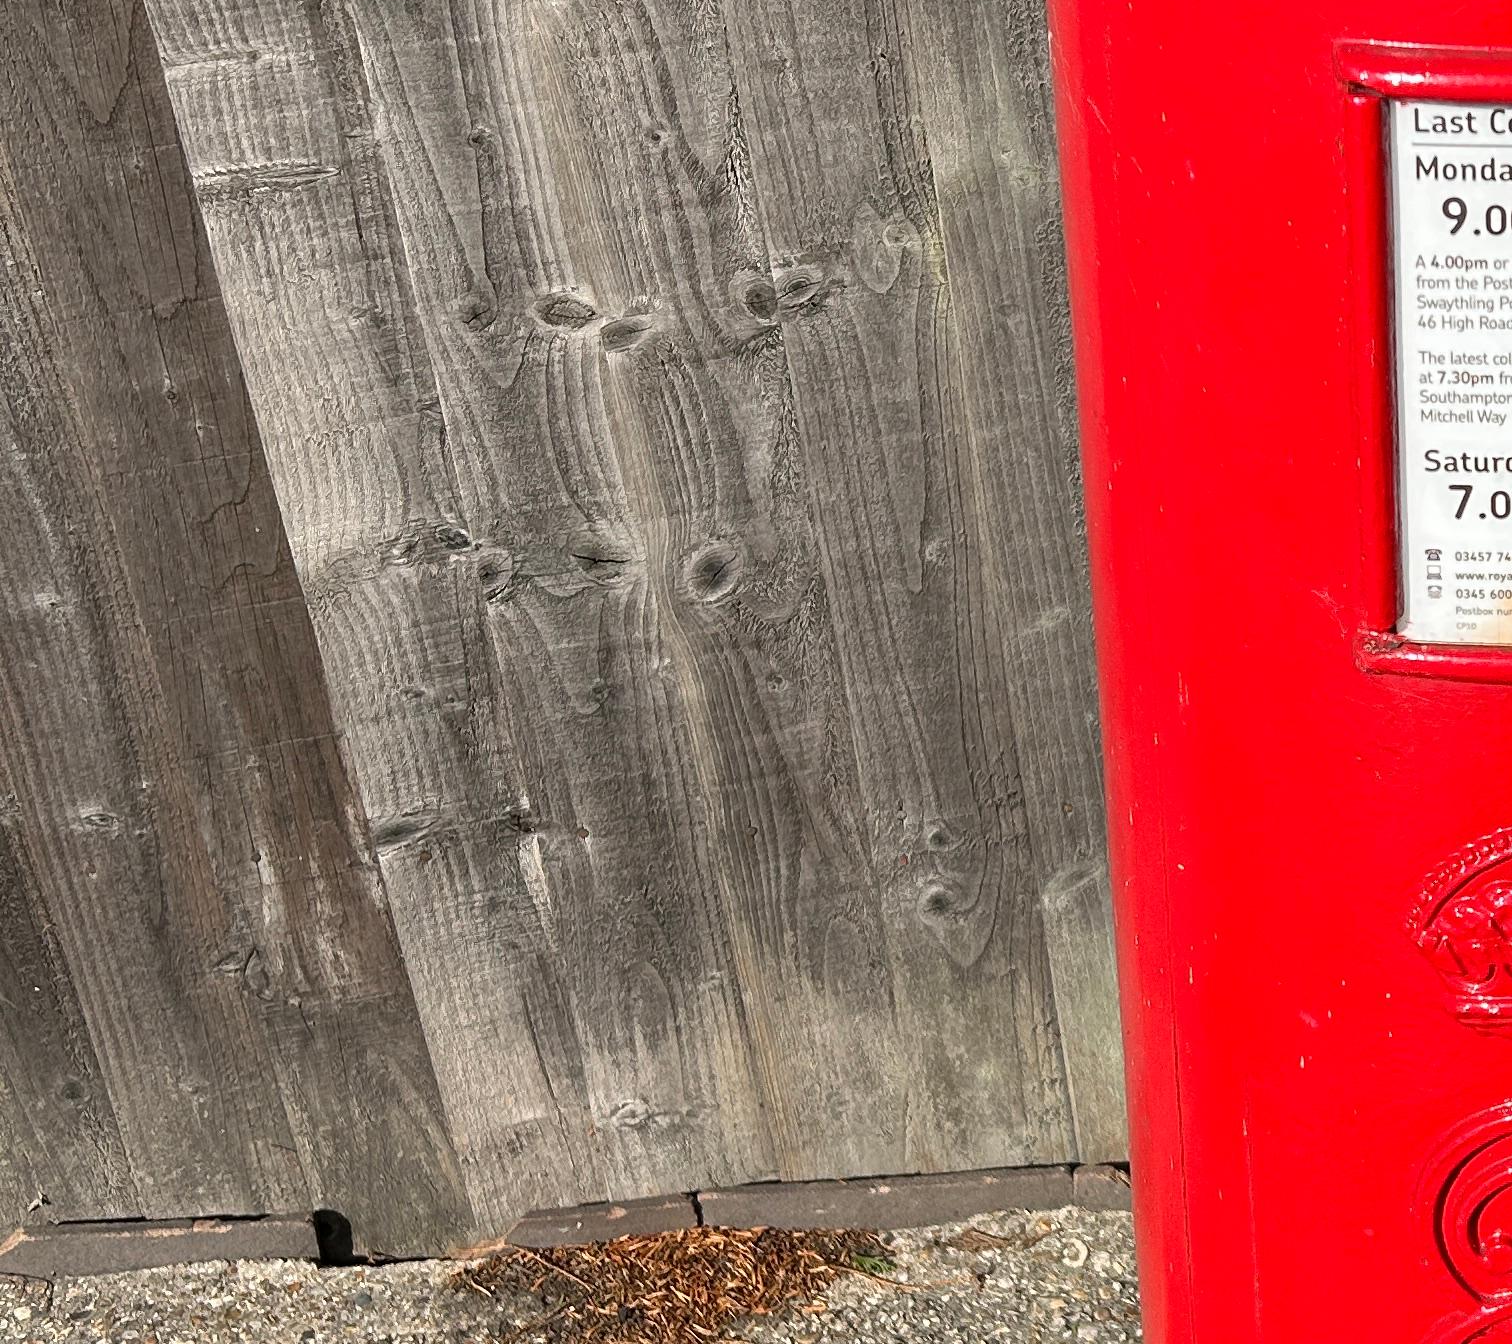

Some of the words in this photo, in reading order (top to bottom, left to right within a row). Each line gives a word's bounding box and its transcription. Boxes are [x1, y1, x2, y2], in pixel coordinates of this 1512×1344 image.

[1414, 108, 1477, 134] Last
[1416, 255, 1426, 269] A
[1431, 255, 1488, 272] 4.00pm
[1494, 259, 1509, 270] or
[1416, 275, 1450, 289] from
[1455, 275, 1479, 290] the
[1417, 295, 1494, 313] Swaythling
[1418, 315, 1436, 329] 46
[1442, 315, 1474, 333] High
[1418, 350, 1446, 365] The
[1451, 351, 1489, 365] latest
[1419, 371, 1433, 384] at
[1437, 370, 1494, 387] 7.30pm
[1420, 409, 1473, 423] Mitchell
[1477, 409, 1507, 426] Way
[1455, 551, 1491, 562] 03457
[1456, 588, 1485, 599] 0345
[1455, 606, 1493, 615] Postbox
